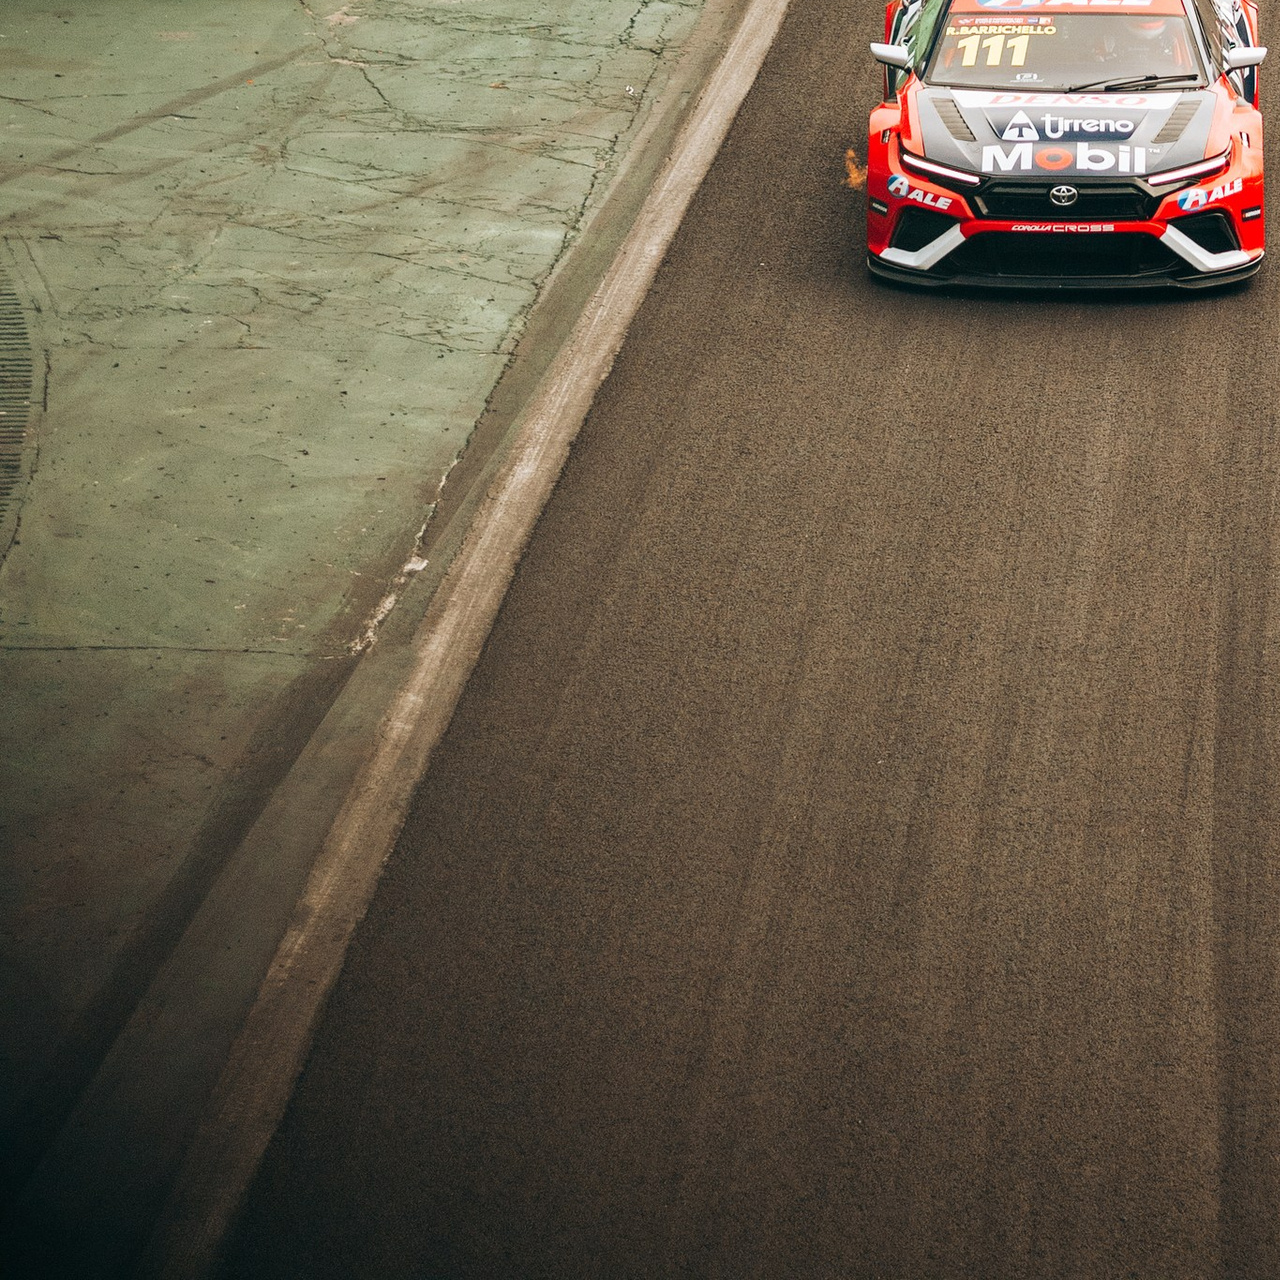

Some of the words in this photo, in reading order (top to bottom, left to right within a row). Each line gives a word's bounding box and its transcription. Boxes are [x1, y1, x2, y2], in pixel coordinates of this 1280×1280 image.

[945, 25, 1057, 36] R.BARRICHELLO
[957, 34, 1030, 67] 111
[988, 94, 1147, 105] DENSO
[981, 142, 1147, 174] Mobil
[907, 189, 954, 210] ALE
[1209, 177, 1243, 202] ALE
[1052, 224, 1115, 232] CROSS
